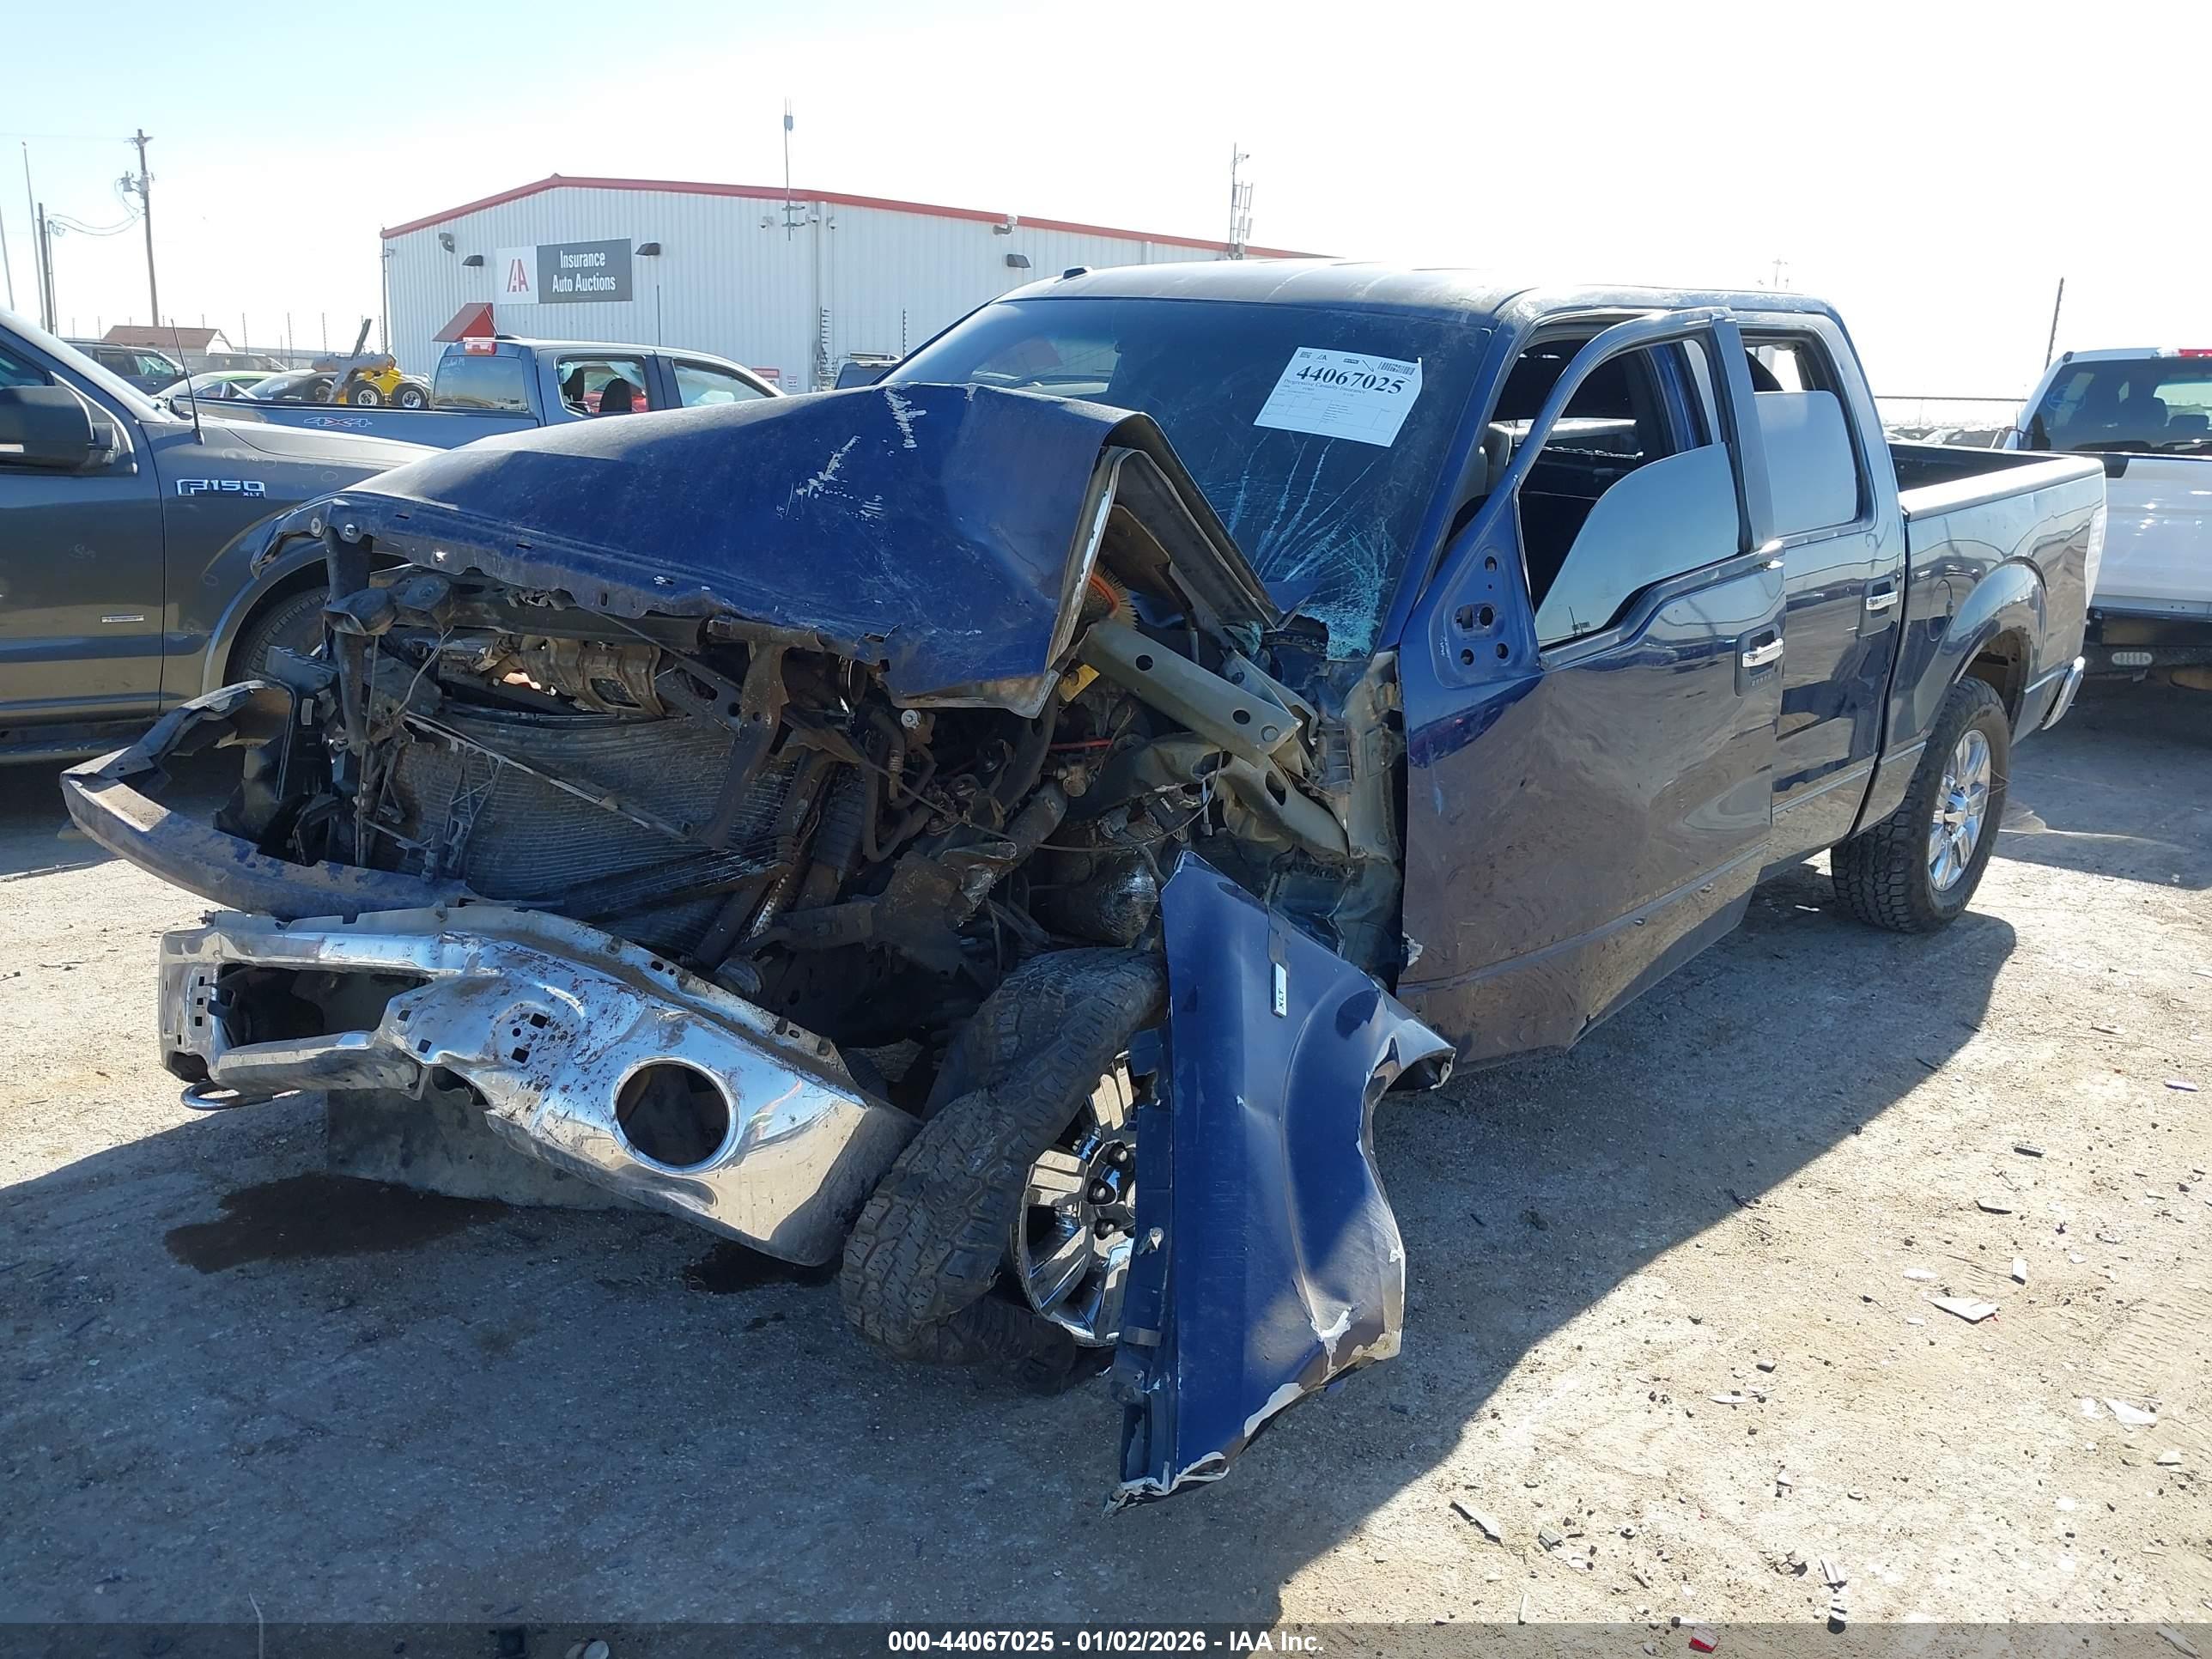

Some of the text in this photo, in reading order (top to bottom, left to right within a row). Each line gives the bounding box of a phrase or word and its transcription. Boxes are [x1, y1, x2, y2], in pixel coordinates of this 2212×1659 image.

[560, 250, 605, 269] Insurance
[552, 271, 616, 293] Auto Auctions
[1297, 365, 1406, 394] 44067025
[1340, 386, 1367, 395] Insurance
